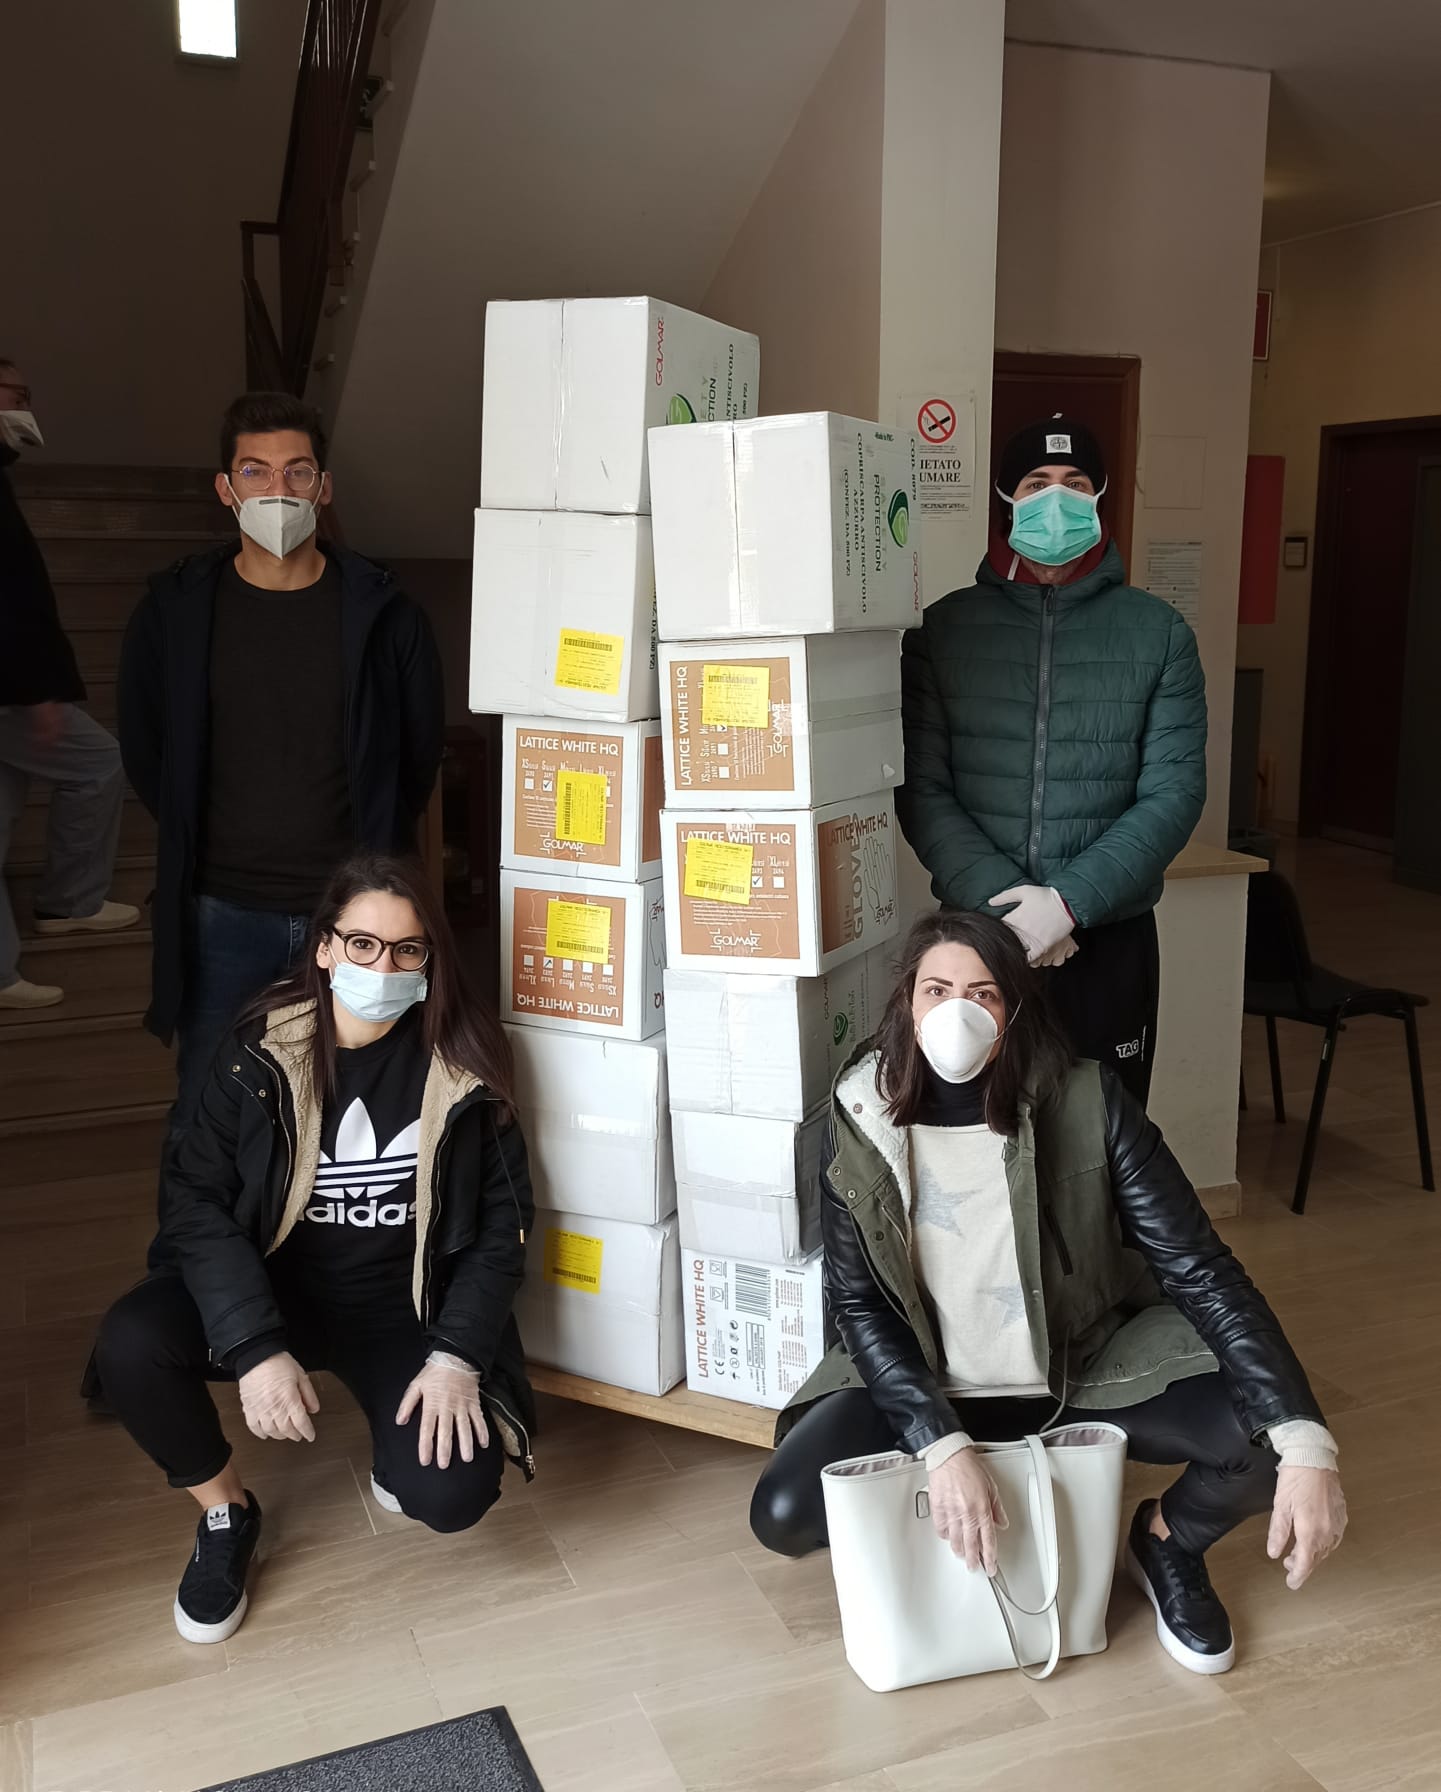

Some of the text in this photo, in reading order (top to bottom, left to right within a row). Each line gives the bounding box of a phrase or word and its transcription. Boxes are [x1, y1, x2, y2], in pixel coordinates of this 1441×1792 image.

[655, 318, 666, 386] GOLMAR
[706, 377, 717, 422] CTION
[919, 472, 961, 483] UMARE
[920, 459, 961, 470] IETATO
[857, 432, 868, 614] COPRISCARPA ANTISCIVOLO
[873, 474, 882, 572] PROTECTION
[912, 551, 920, 613] GOLMAR
[675, 666, 693, 786] LATTICE WHITE HQ
[519, 735, 619, 757] LATTICE WHITE HQ
[681, 830, 792, 845] LATTICE WHITE HQ
[855, 814, 877, 838] WHITE
[878, 811, 889, 831] HQ
[542, 838, 585, 853] GOLMAR
[713, 935, 759, 947] GOLMAR
[516, 992, 619, 1018] LATTICE WHITE HQ
[693, 1259, 709, 1378] LATTICE WHITE HQ
